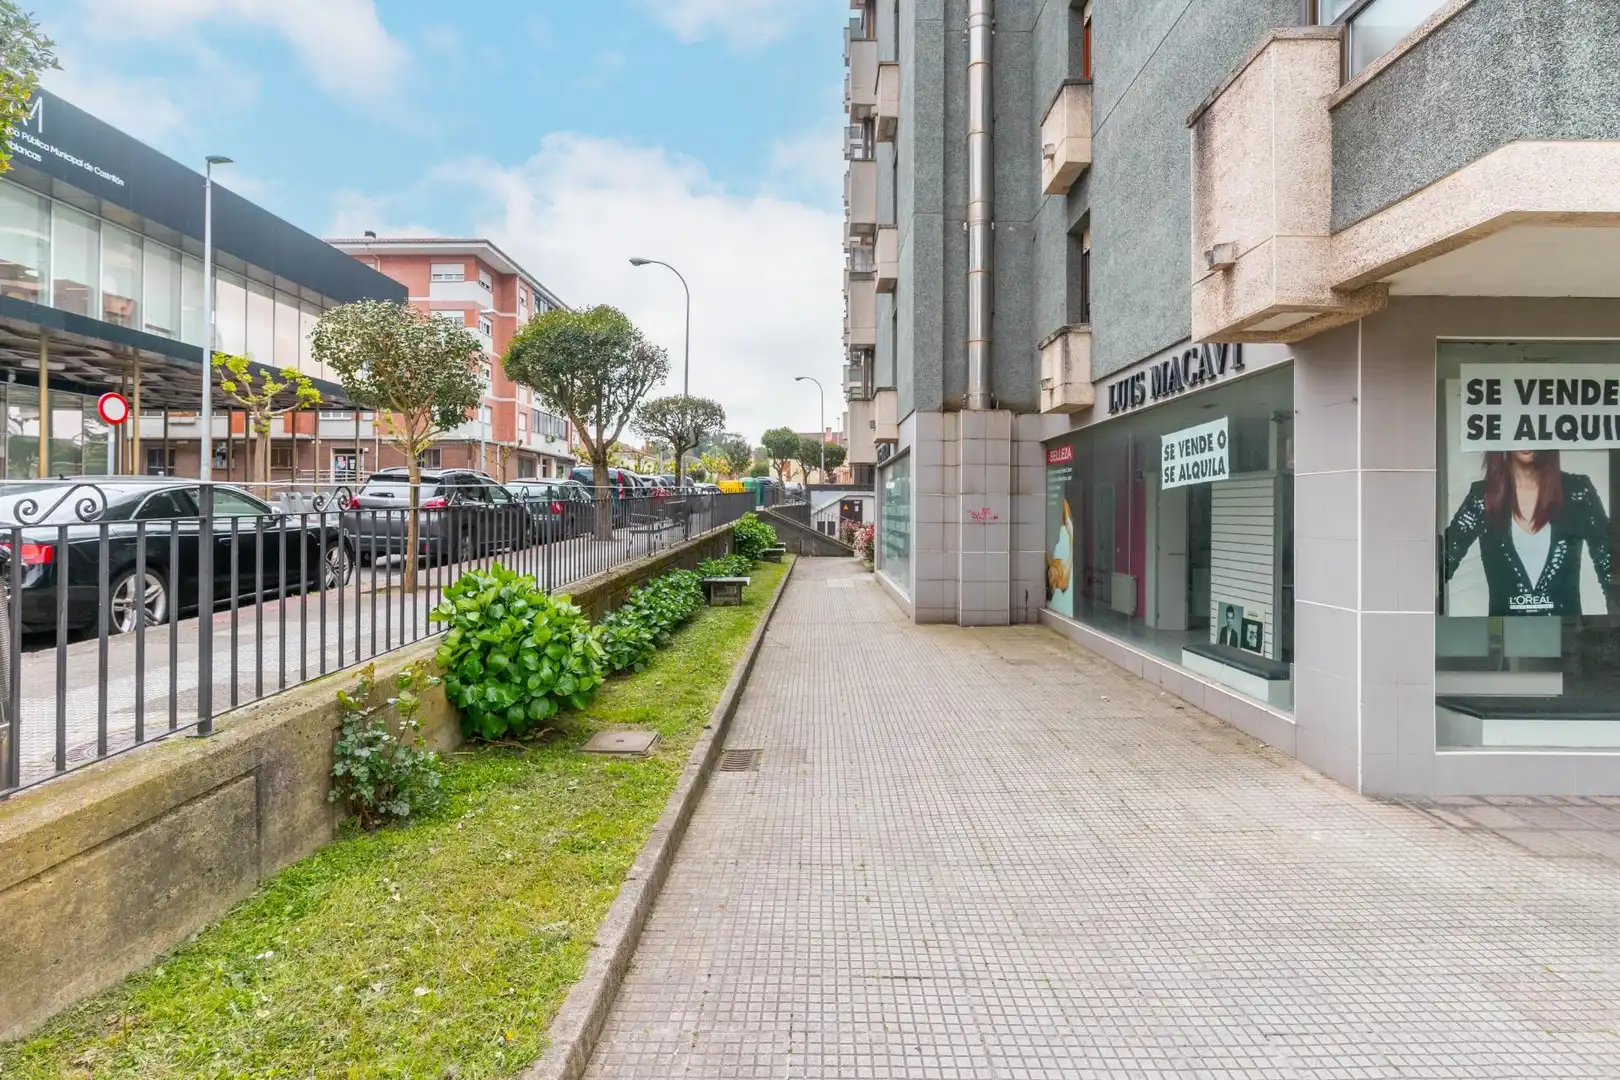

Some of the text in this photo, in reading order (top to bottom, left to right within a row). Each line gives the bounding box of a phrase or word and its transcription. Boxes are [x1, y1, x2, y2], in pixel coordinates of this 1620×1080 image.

[50, 145, 83, 167] Municipal
[84, 162, 94, 172] de
[1108, 371, 1146, 414] LUIS
[1466, 378, 1620, 405] SE VENDE
[1466, 414, 1501, 440] SE
[1049, 446, 1072, 462] BELLEZA
[1164, 429, 1226, 461] SE VENDE O
[1164, 456, 1226, 483] SE ALQUILA
